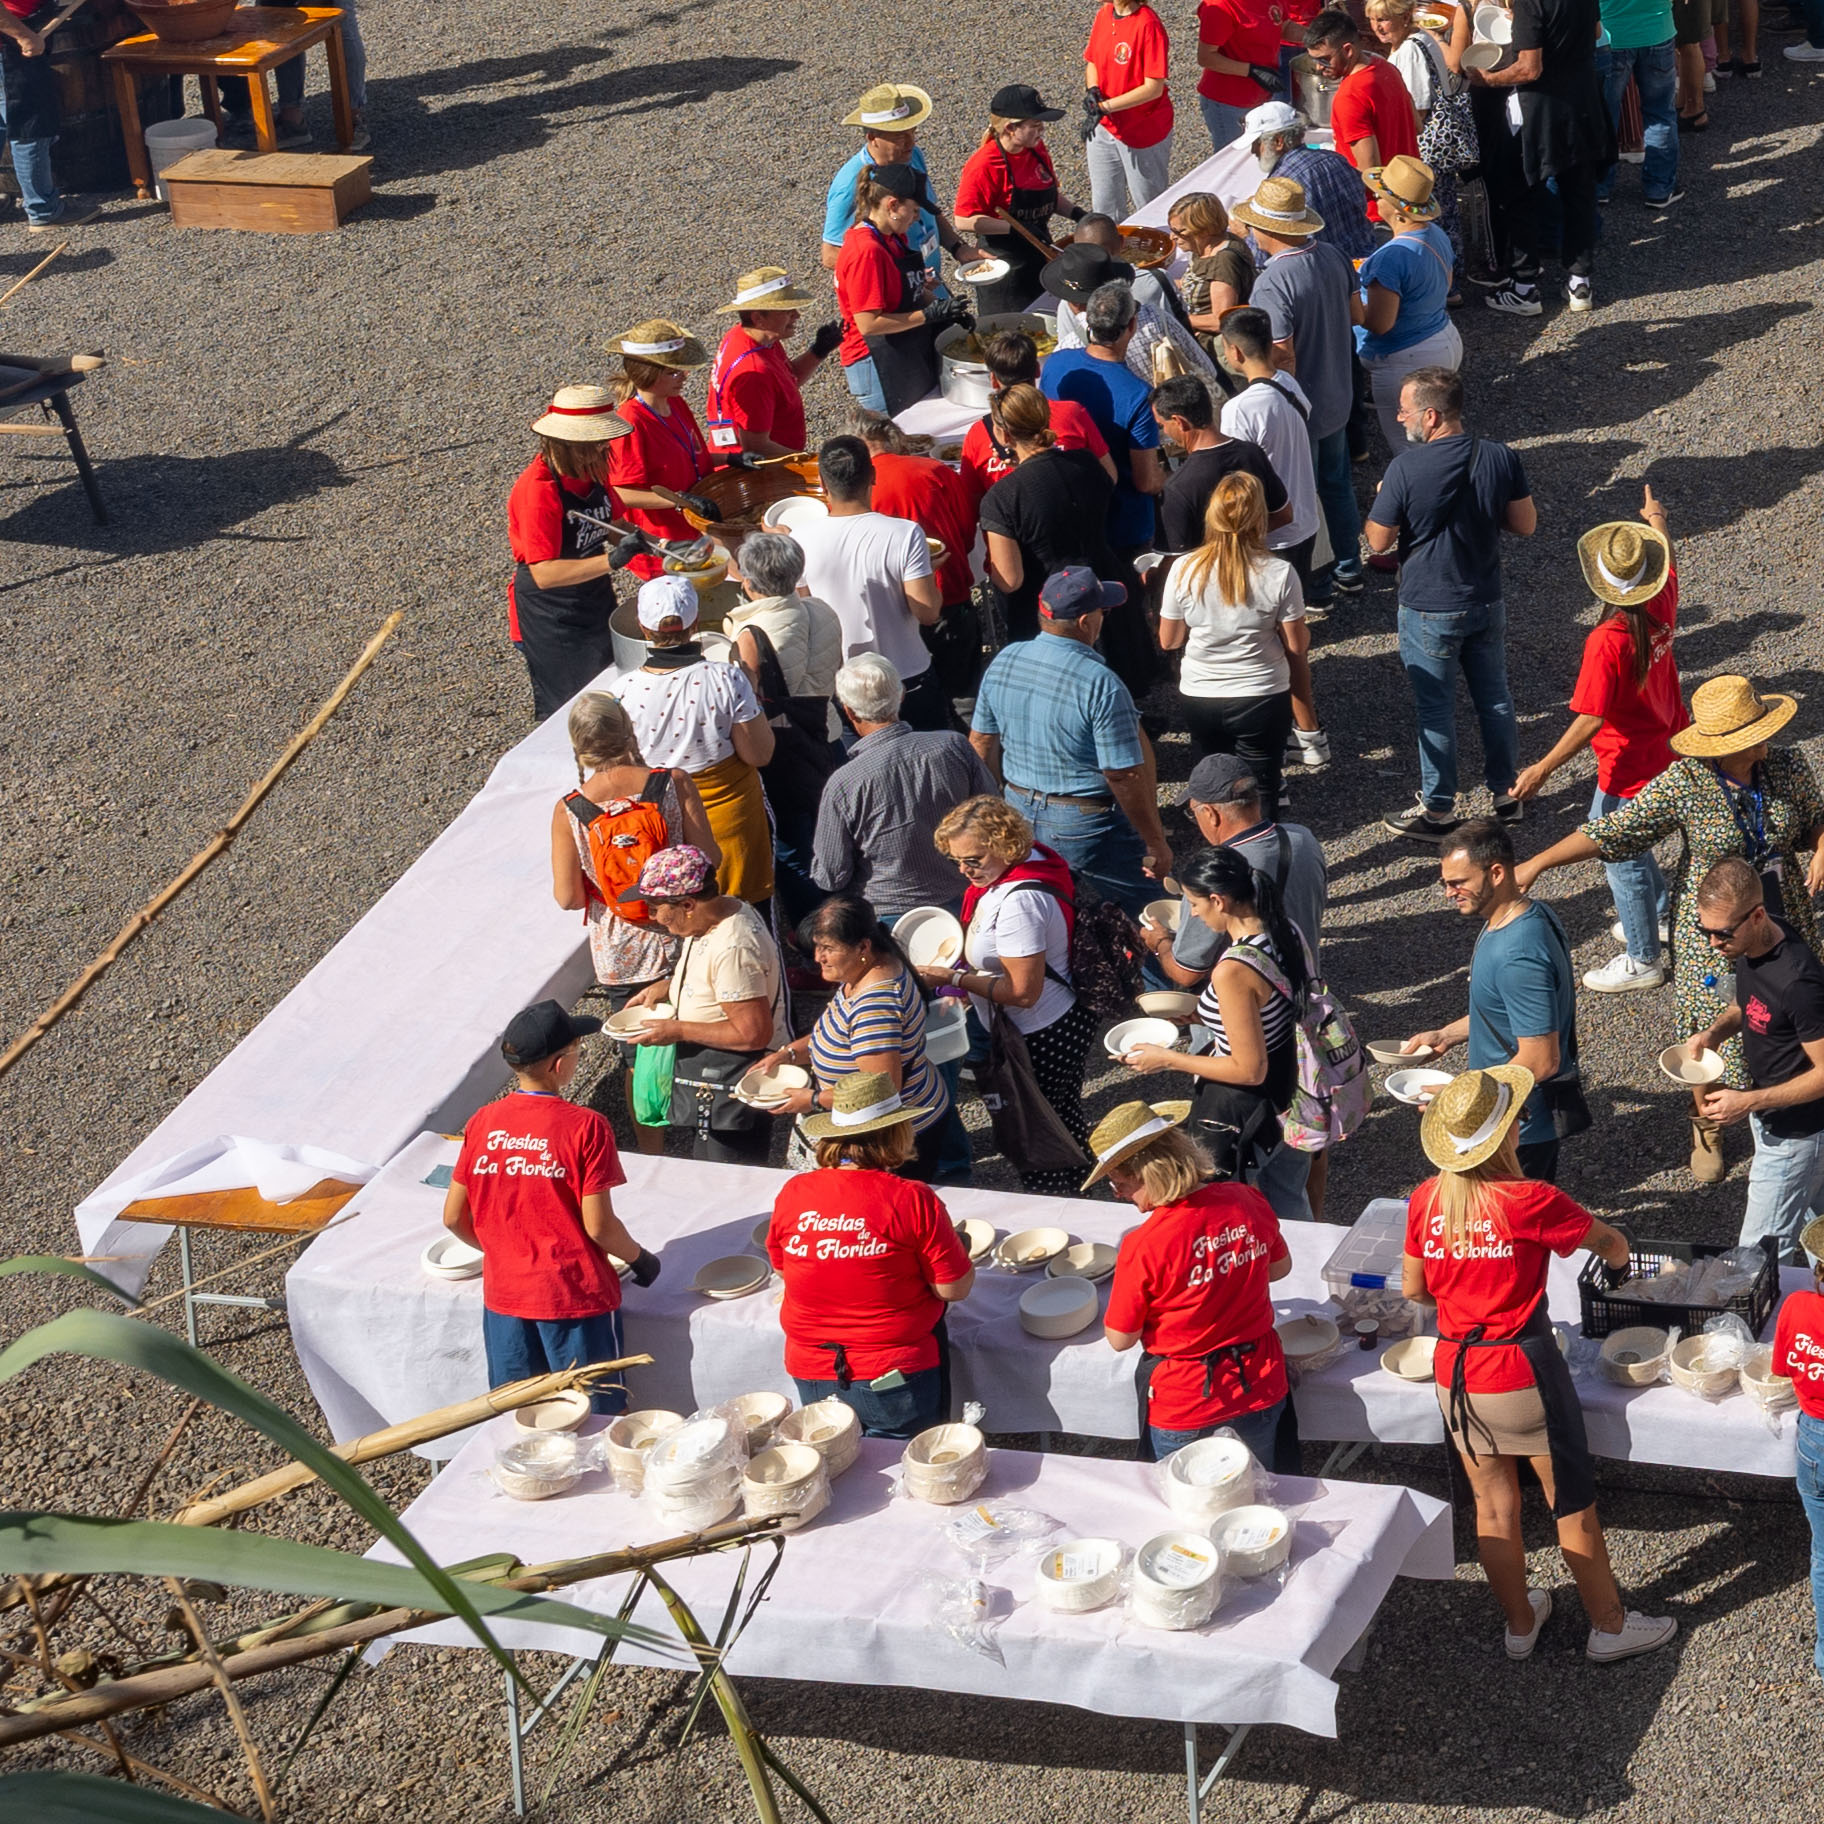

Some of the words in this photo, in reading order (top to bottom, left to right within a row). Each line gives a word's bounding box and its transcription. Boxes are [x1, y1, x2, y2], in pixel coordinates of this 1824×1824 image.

[487, 1129, 549, 1152] Fiestas
[473, 1155, 499, 1176] La
[505, 1155, 566, 1178] Florida
[540, 1150, 552, 1162] de
[797, 1210, 866, 1233] Fiestas
[857, 1228, 871, 1241] de
[1192, 1222, 1249, 1259] Fiestas
[1244, 1232, 1255, 1244] de
[1485, 1229, 1497, 1243] de
[784, 1235, 809, 1257] La
[815, 1237, 888, 1260] Florida
[1422, 1240, 1445, 1260] La
[1452, 1240, 1514, 1260] Florida
[1187, 1263, 1214, 1288] La
[1216, 1241, 1268, 1275] Florida
[1786, 1351, 1806, 1373] La
